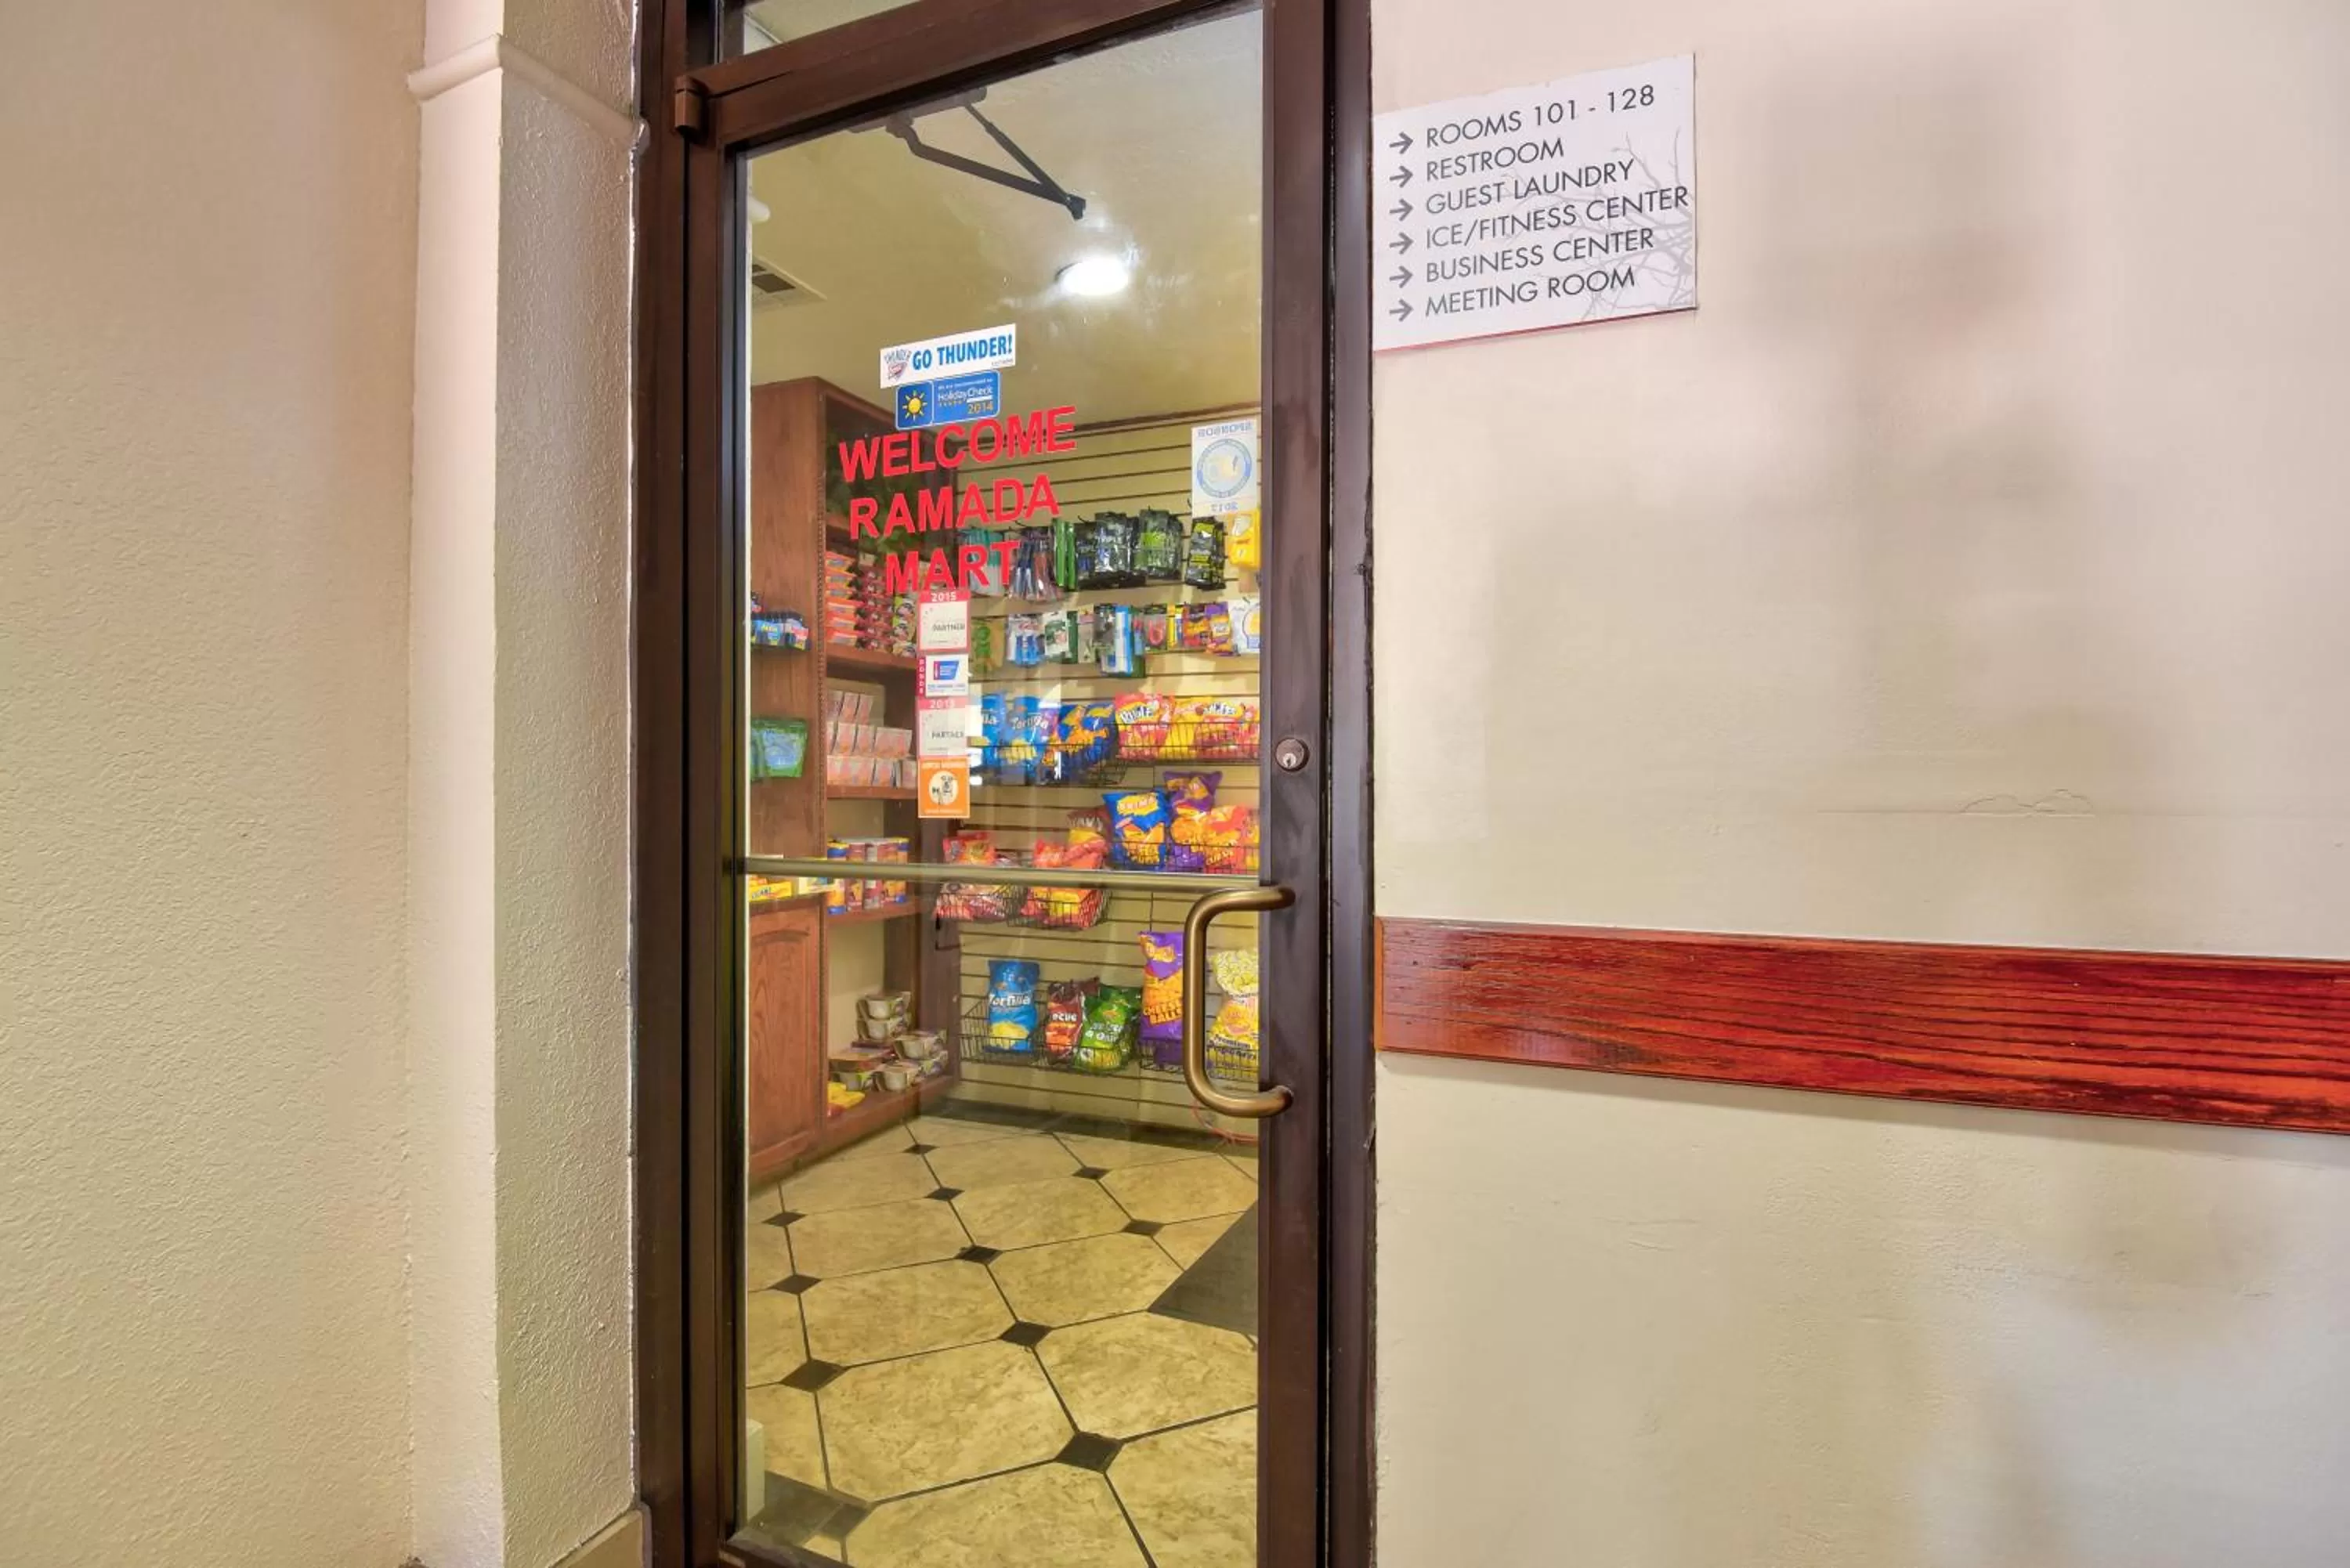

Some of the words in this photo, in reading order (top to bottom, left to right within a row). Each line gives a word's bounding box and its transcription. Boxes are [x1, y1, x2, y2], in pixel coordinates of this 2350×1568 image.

[1426, 110, 1521, 148] ROOMS
[1534, 99, 1576, 126] 101
[1607, 84, 1655, 113] 128
[1426, 138, 1564, 182] RESTROOM
[1426, 182, 1506, 215] GUEST
[1513, 158, 1635, 200] LAUNDRY
[1426, 204, 1577, 248] ICE/FITNESS
[1585, 186, 1690, 222] CENTER
[1426, 245, 1544, 283] BUSINESS
[1553, 228, 1654, 262] CENTER
[1425, 280, 1538, 317] MEETING
[1548, 266, 1636, 298] ROOM
[913, 350, 932, 371] GO
[937, 334, 1013, 366] THUNDER!
[967, 400, 994, 414] 2014
[839, 406, 1077, 483] WELCOME
[849, 473, 1060, 540] RAMADA
[886, 540, 1021, 595] MART
[931, 591, 957, 602] 2015
